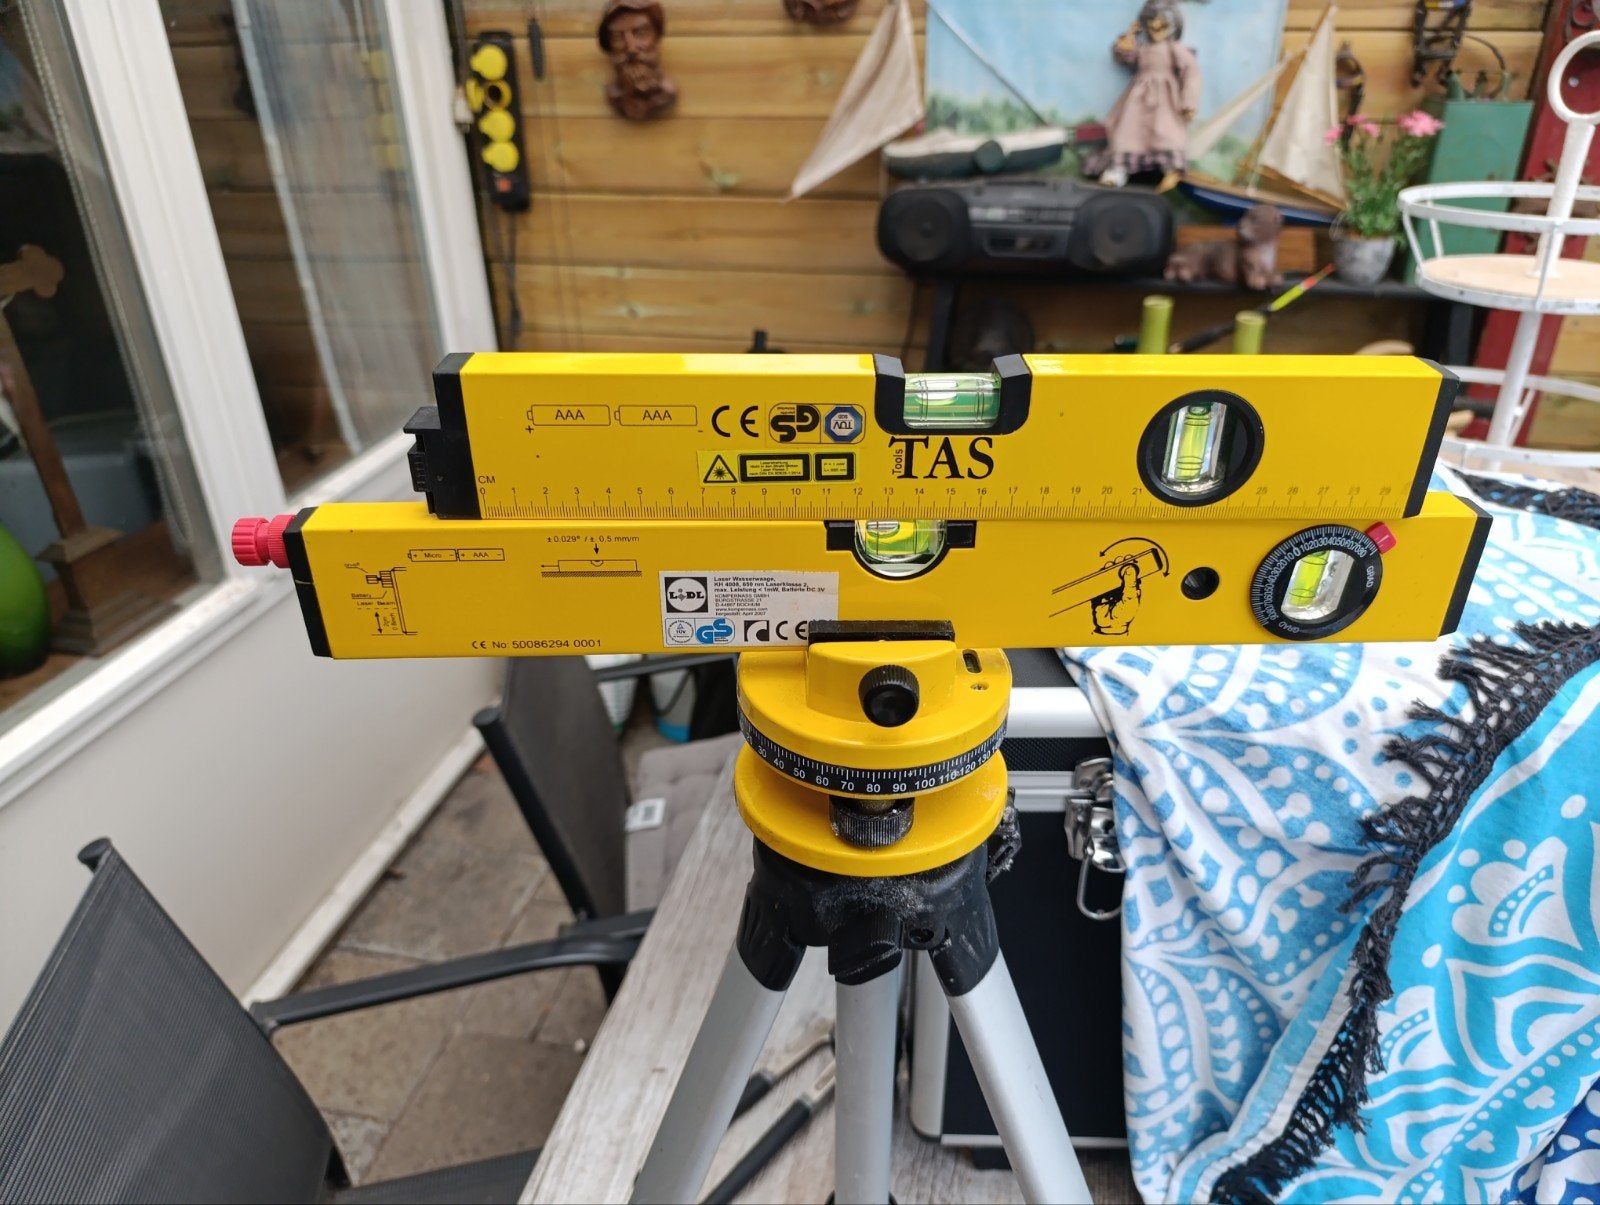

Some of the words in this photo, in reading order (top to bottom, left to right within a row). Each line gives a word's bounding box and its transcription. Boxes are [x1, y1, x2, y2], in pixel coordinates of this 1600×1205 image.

[554, 409, 585, 421] AAA
[642, 409, 672, 421] AAA
[711, 405, 759, 438] CE
[888, 436, 995, 480] TAS
[892, 448, 903, 475] Tools
[478, 475, 496, 484] CM
[791, 487, 801, 495] 10
[822, 487, 831, 495] 11
[853, 487, 863, 495] 12
[884, 487, 893, 495] 13
[915, 487, 924, 495] 14
[946, 487, 955, 495] 15
[977, 487, 987, 495] 16
[1008, 487, 1018, 495] 17
[1040, 487, 1049, 495] 18
[1071, 487, 1081, 495] 19
[1101, 487, 1112, 495] 20
[1132, 487, 1143, 495] 21
[1270, 566, 1281, 576] 30
[1276, 558, 1287, 570] 20
[1284, 552, 1295, 562] 10
[1308, 539, 1319, 550] 20
[1318, 537, 1328, 546] 30
[775, 620, 808, 640] CE
[1278, 620, 1300, 634] GRAD
[512, 639, 570, 649] 50086294
[573, 639, 601, 648] 0001
[757, 745, 767, 758] 30
[773, 757, 785, 769] 40
[793, 767, 806, 779] 50
[815, 775, 829, 787] 60
[840, 780, 855, 791] 70
[866, 783, 881, 793] 80
[892, 783, 907, 793] 90
[914, 777, 936, 790] 100
[939, 769, 957, 784] 110
[960, 761, 976, 777] 120
[977, 750, 991, 766] 130
